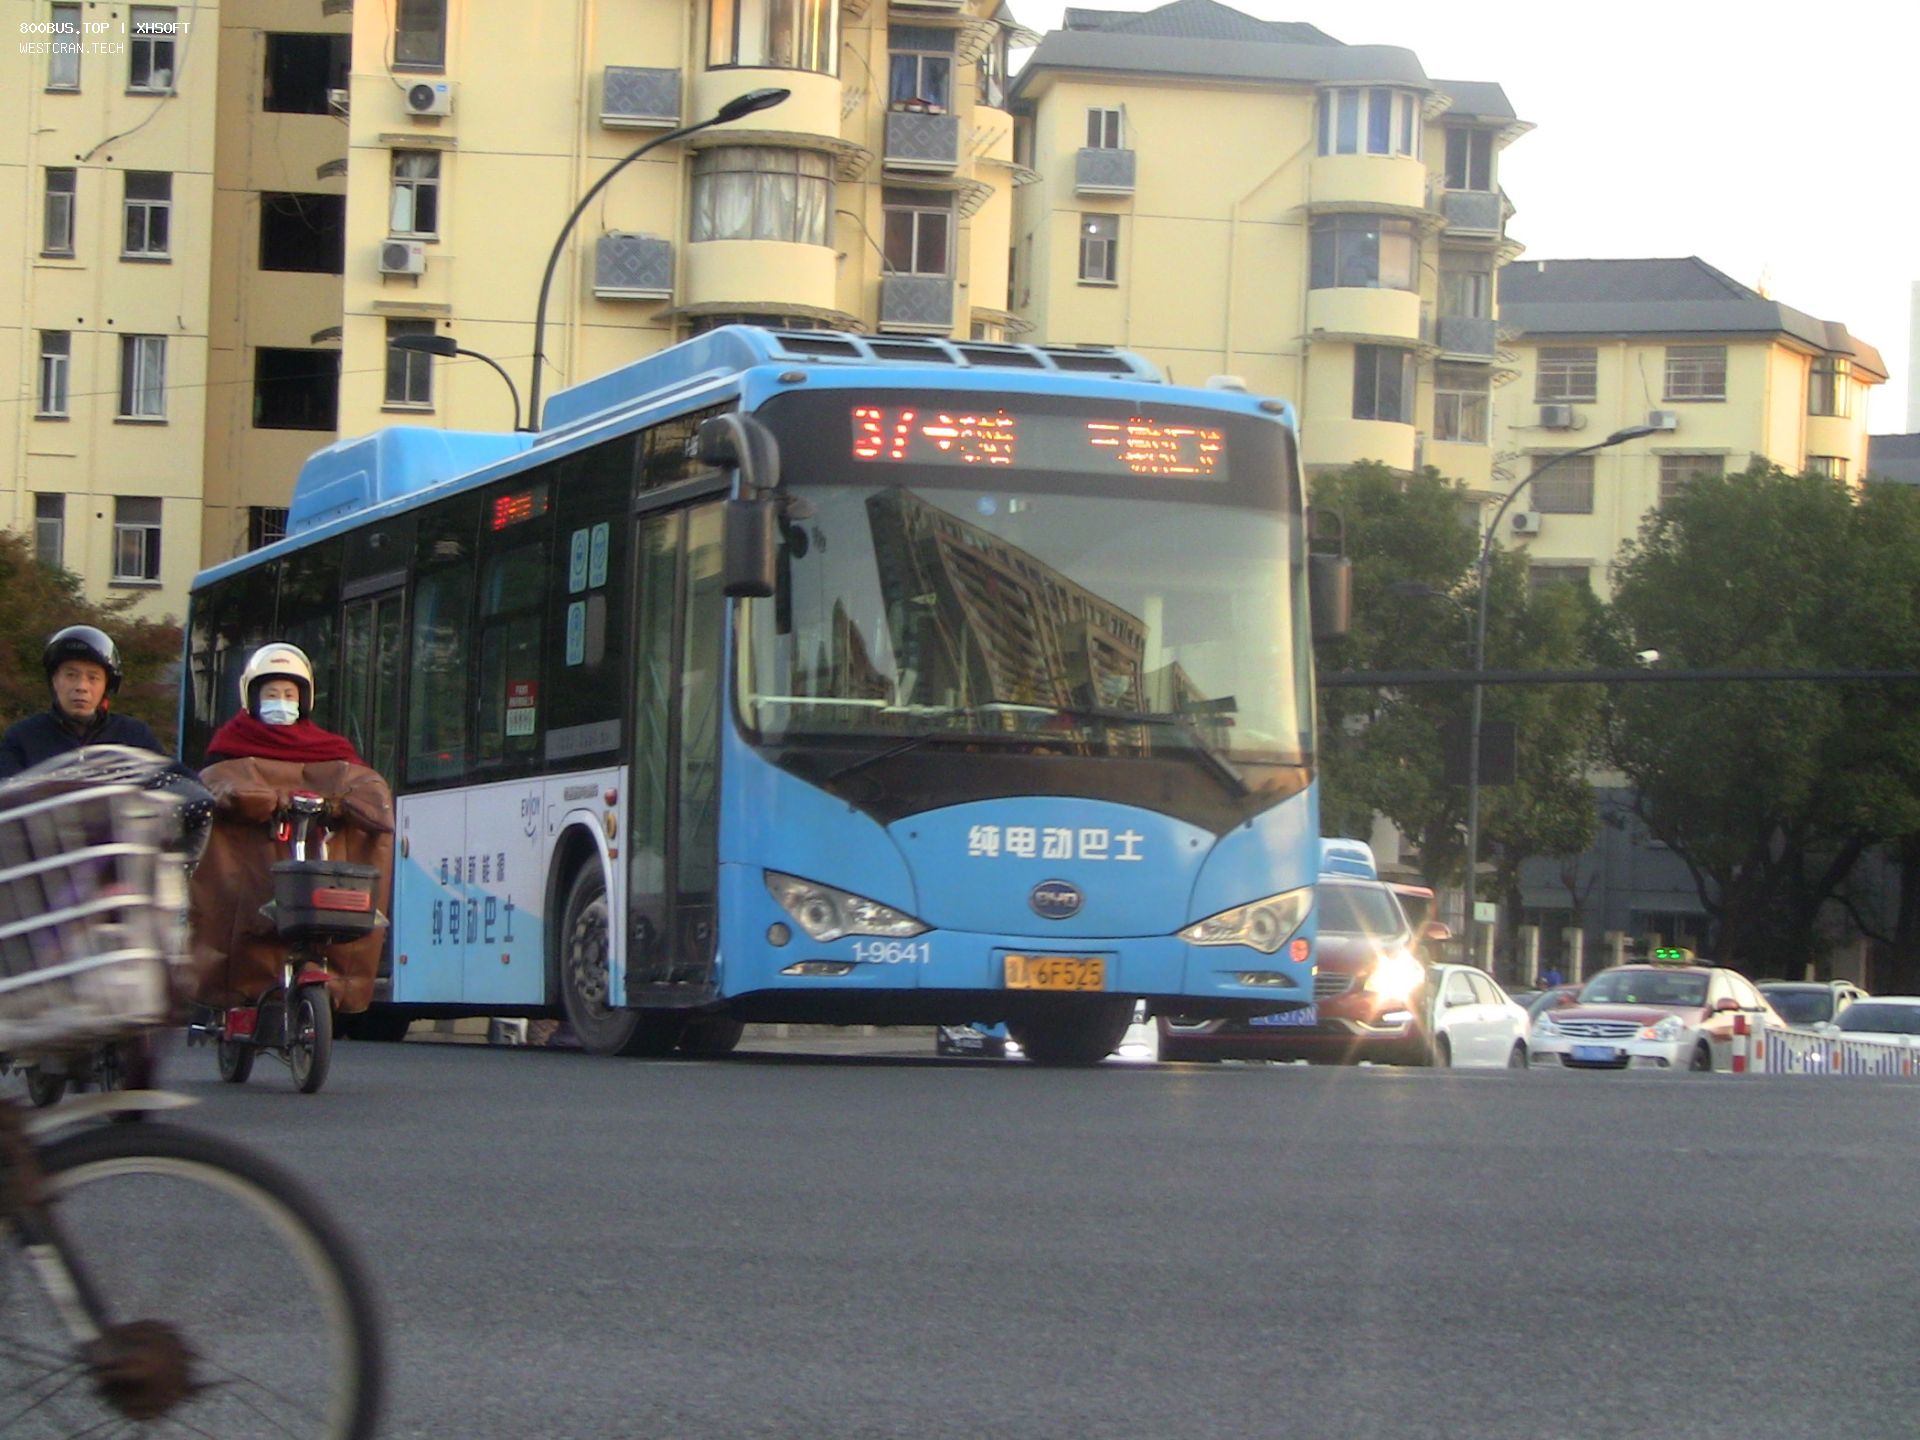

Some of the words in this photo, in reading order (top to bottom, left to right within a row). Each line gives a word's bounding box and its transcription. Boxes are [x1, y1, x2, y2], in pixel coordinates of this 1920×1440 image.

[968, 825, 1144, 862] 纯电动巴士
[851, 941, 930, 964] 1-9641
